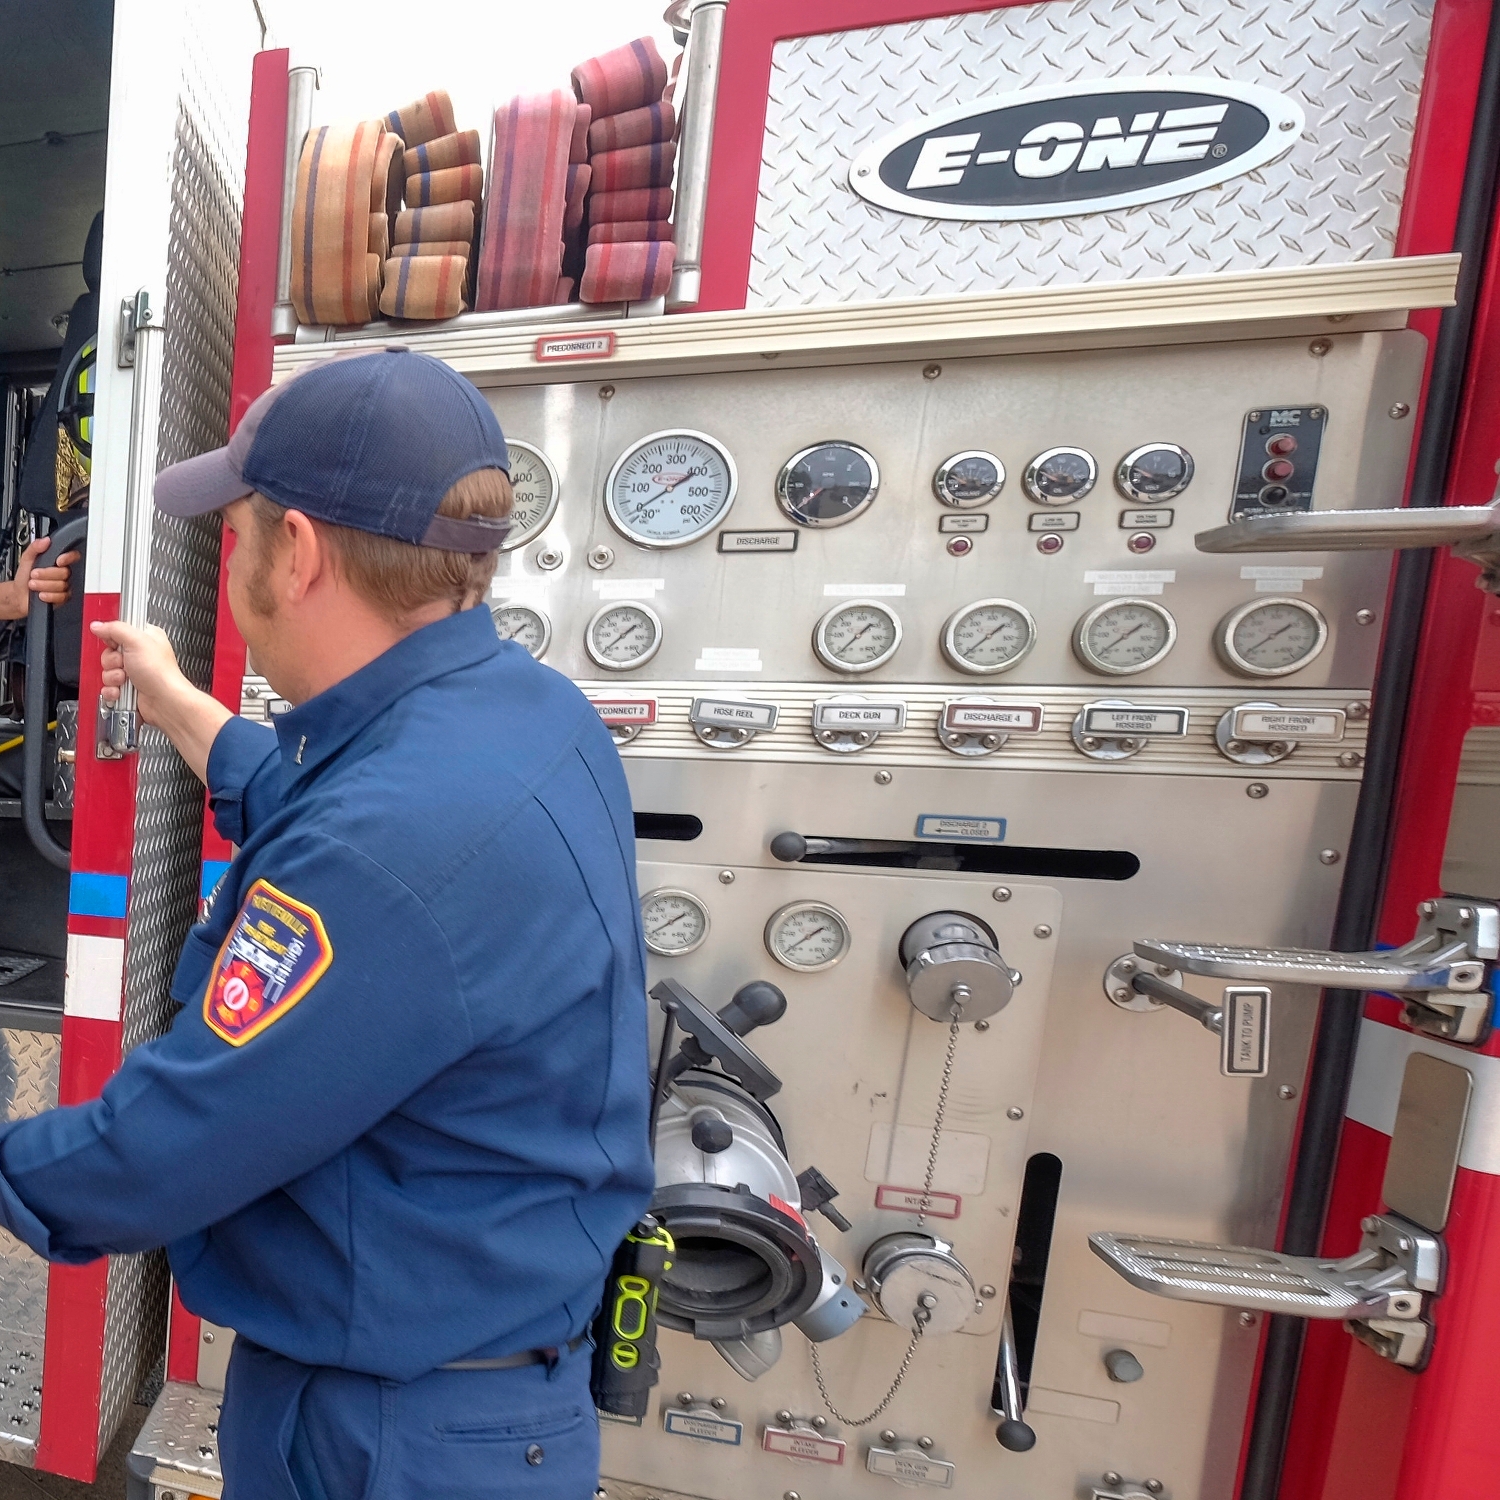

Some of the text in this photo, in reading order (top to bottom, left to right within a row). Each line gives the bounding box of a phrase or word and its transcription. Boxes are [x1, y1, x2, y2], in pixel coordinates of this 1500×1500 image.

[906, 104, 1230, 190] E-ONE
[547, 341, 603, 352] PRECONNECT 2
[666, 455, 686, 465] 300
[642, 464, 662, 474] 200
[631, 483, 649, 493] 100
[688, 487, 708, 497] 500
[680, 505, 700, 515] 600
[596, 707, 638, 715] ECONNECT
[714, 708, 754, 718] HOSE REEL
[839, 711, 881, 720] DECK GUN
[963, 713, 1021, 722] DISCHARGE 4
[1240, 1002, 1253, 1062] TANK TO PUMP
